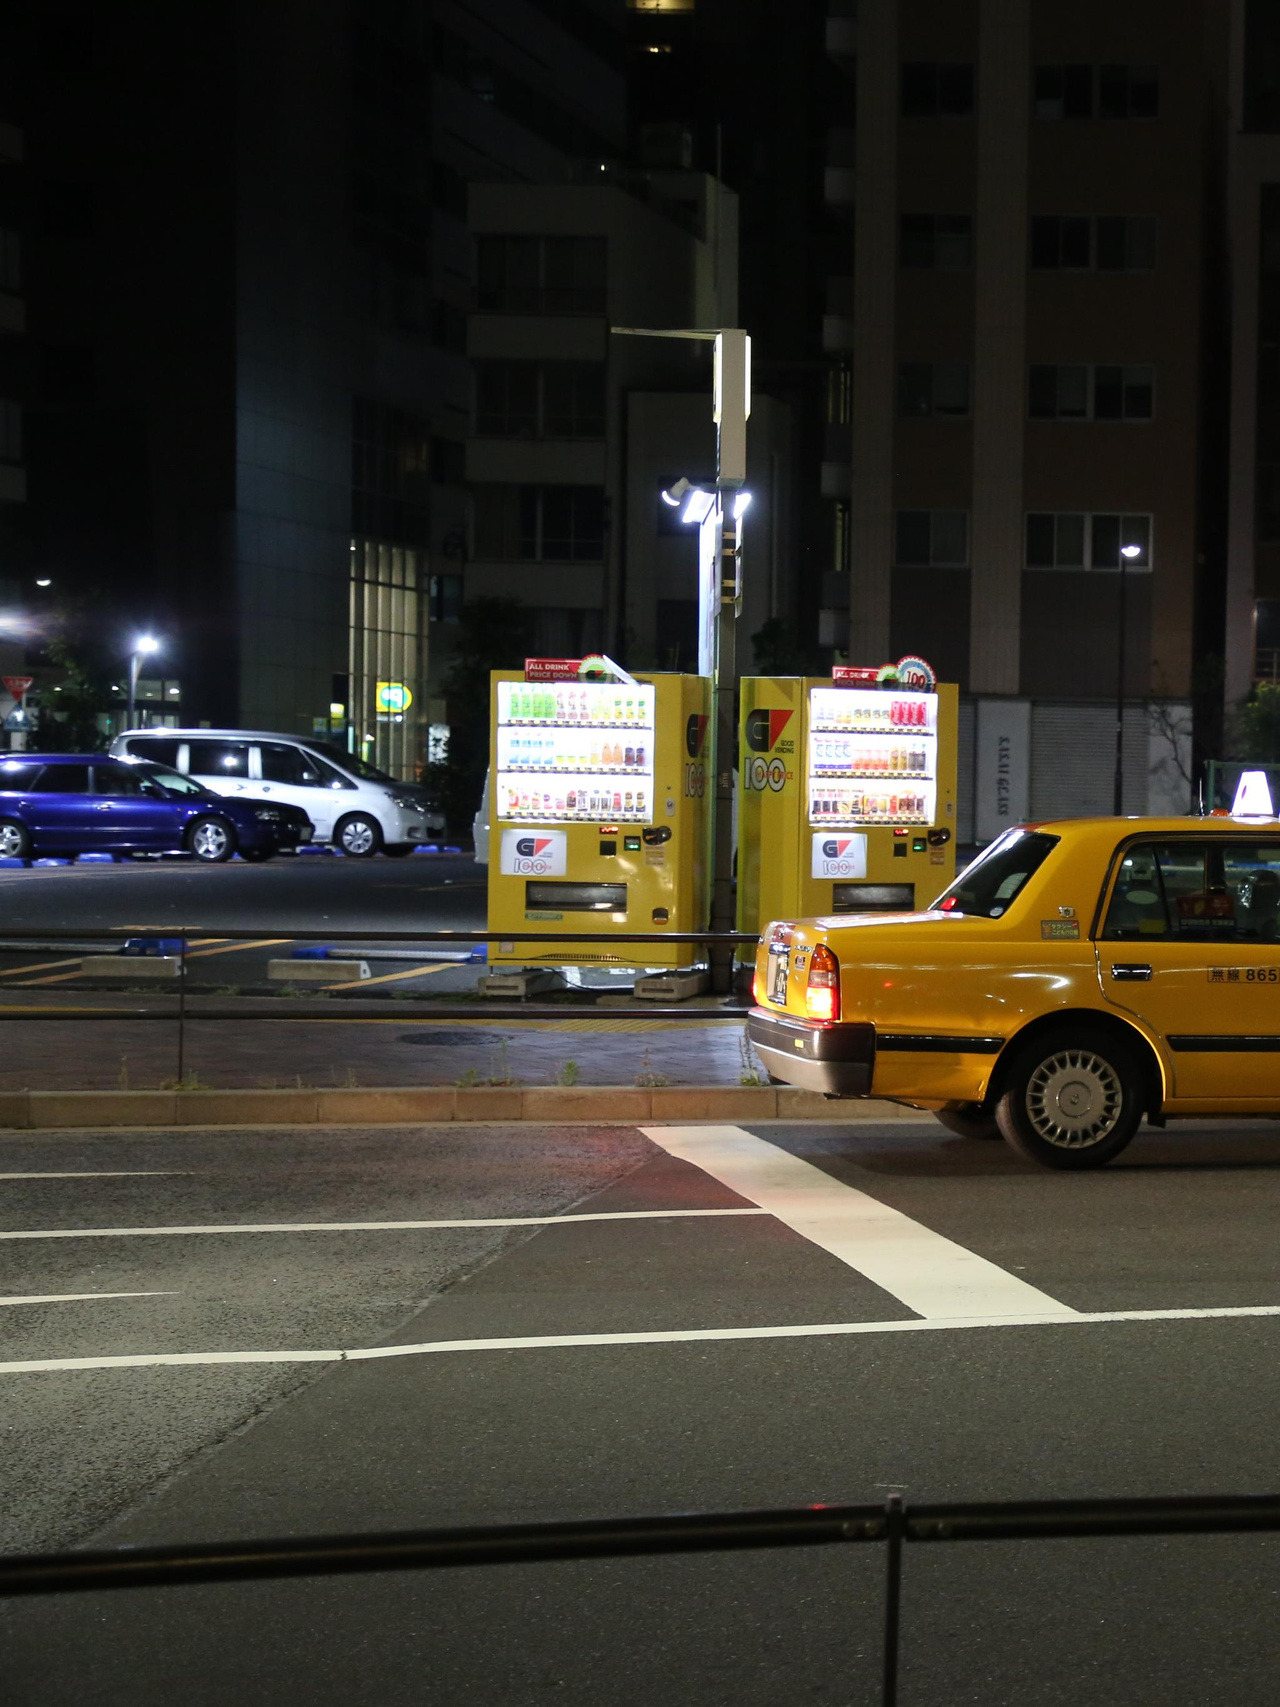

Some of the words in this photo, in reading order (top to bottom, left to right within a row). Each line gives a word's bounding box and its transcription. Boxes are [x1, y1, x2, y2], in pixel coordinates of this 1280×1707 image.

[553, 671, 578, 679] DOWN
[906, 670, 926, 689] 100
[744, 757, 786, 792] 100
[514, 858, 547, 874] 100
[823, 860, 850, 875] 100
[1211, 969, 1240, 981] 無線
[1246, 969, 1278, 982] 865
